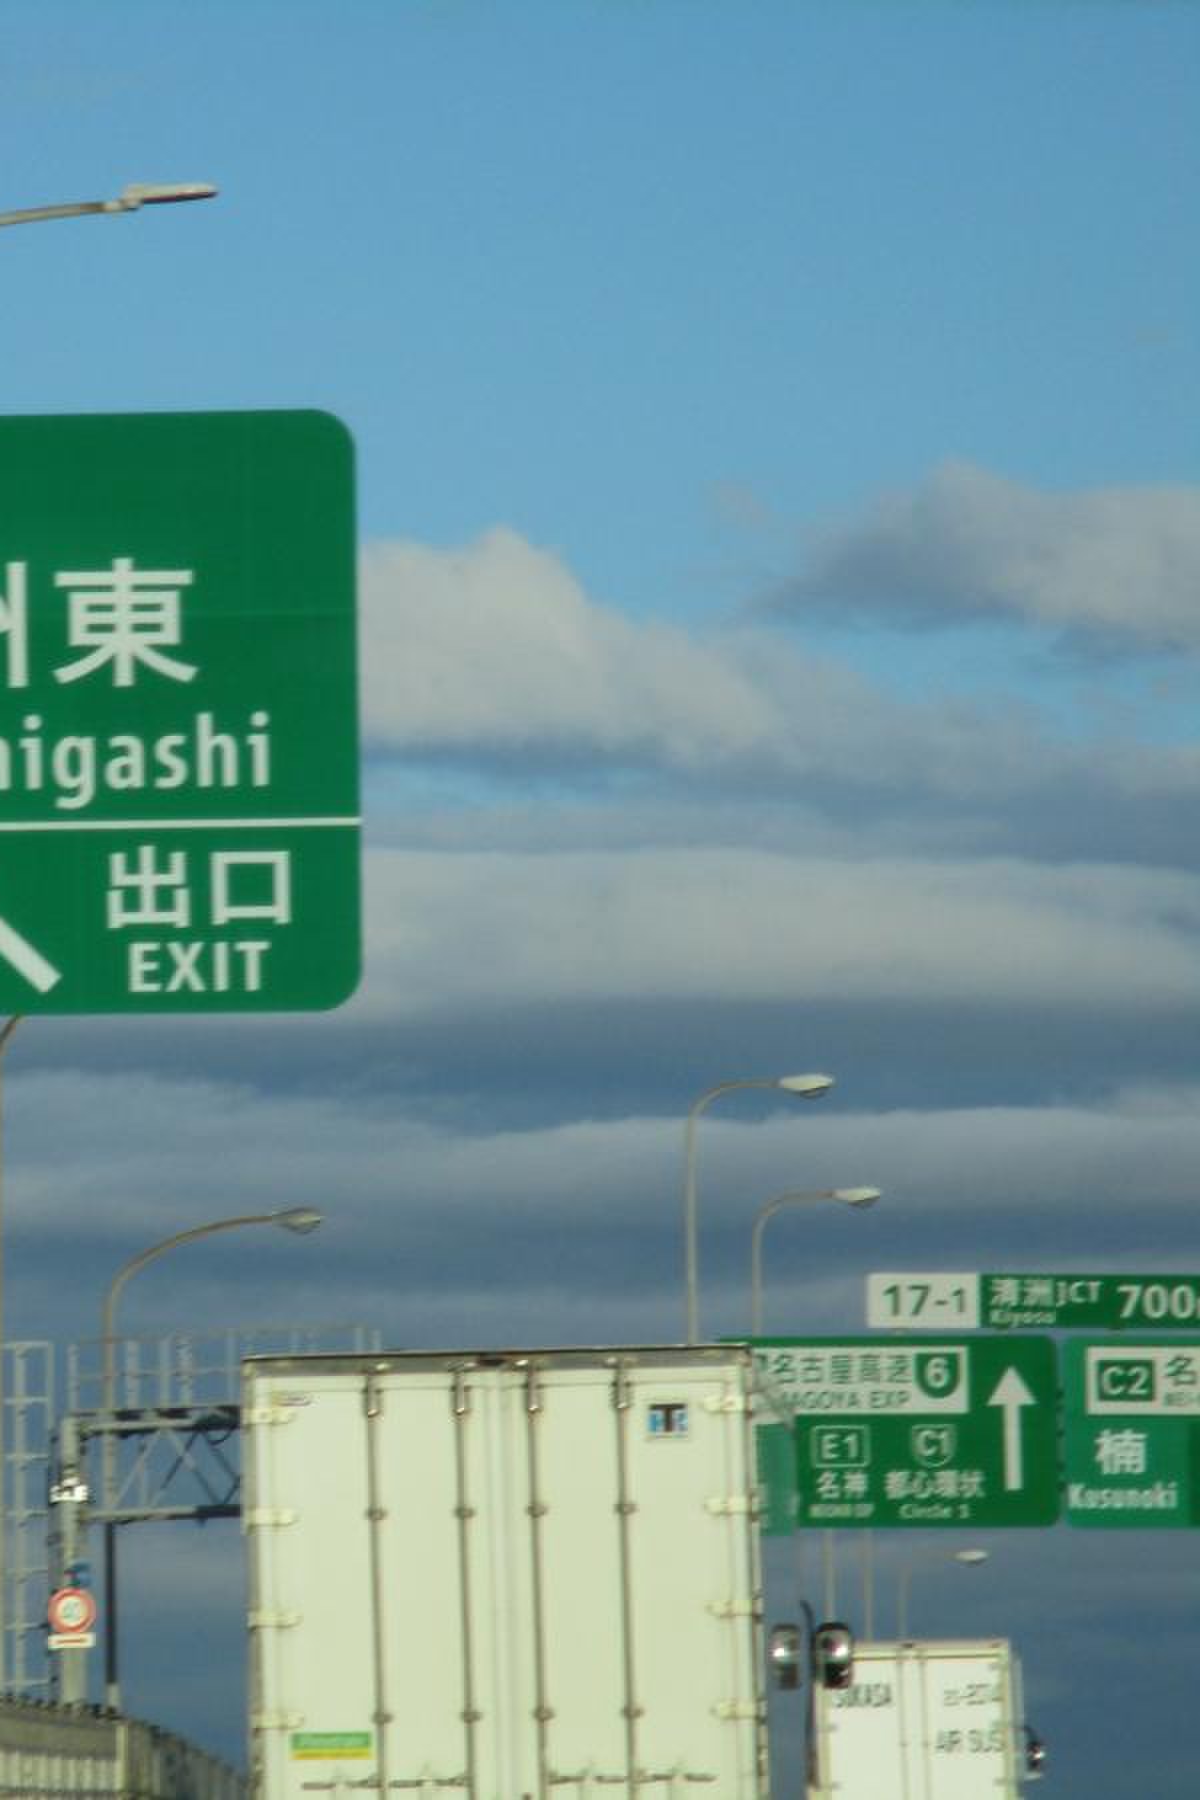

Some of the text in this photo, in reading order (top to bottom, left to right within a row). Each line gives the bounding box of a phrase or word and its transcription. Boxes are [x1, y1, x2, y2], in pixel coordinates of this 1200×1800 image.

[105, 845, 291, 929] 出口
[128, 941, 271, 994] EXIT
[883, 1284, 966, 1317] 17-1
[1116, 1283, 1200, 1319] 700
[924, 1356, 950, 1389] 6
[1103, 1365, 1149, 1395] C2
[821, 1433, 859, 1460] E1
[918, 1430, 950, 1457] C1
